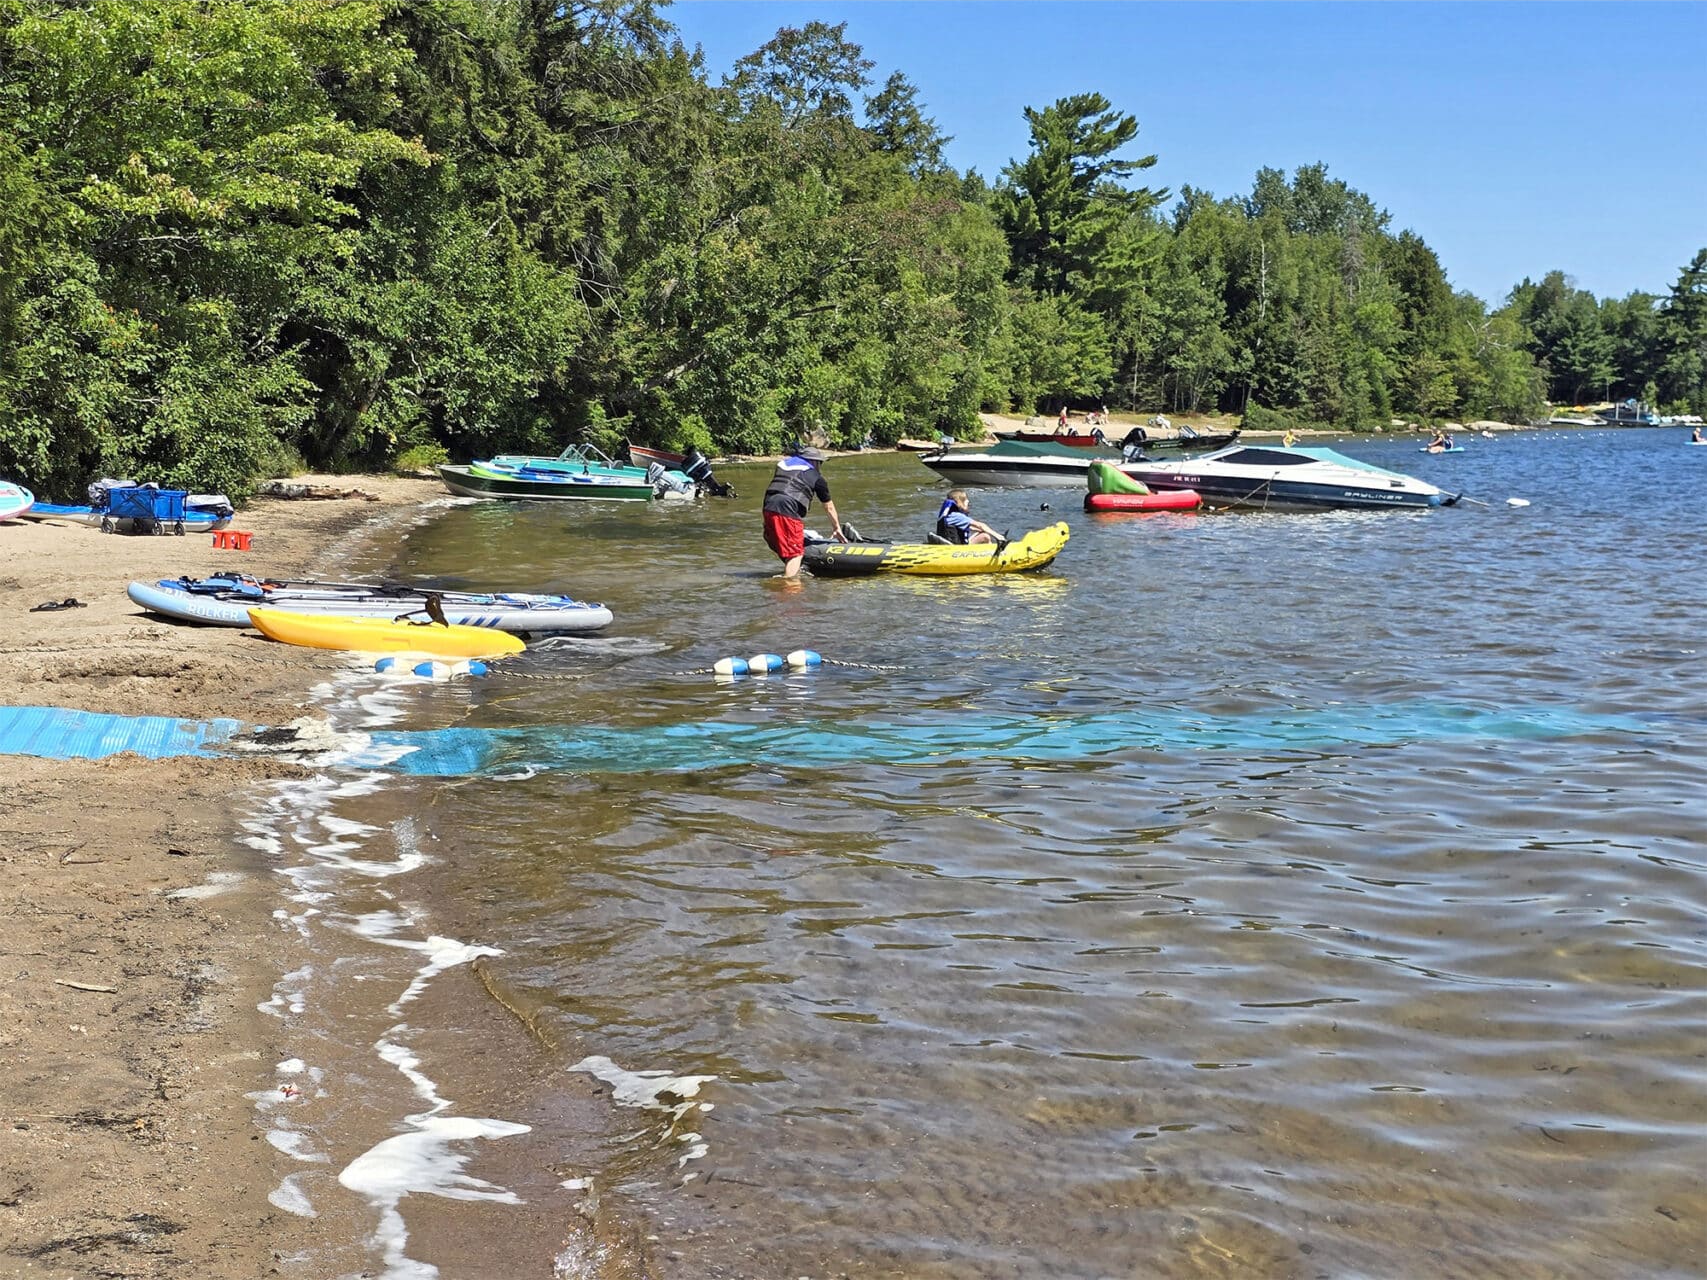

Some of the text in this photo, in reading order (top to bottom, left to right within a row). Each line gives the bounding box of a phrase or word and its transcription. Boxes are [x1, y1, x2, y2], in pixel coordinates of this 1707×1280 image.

[1344, 491, 1403, 500] BAYLINER
[825, 545, 845, 556] K2
[187, 603, 240, 621] ROCKER
